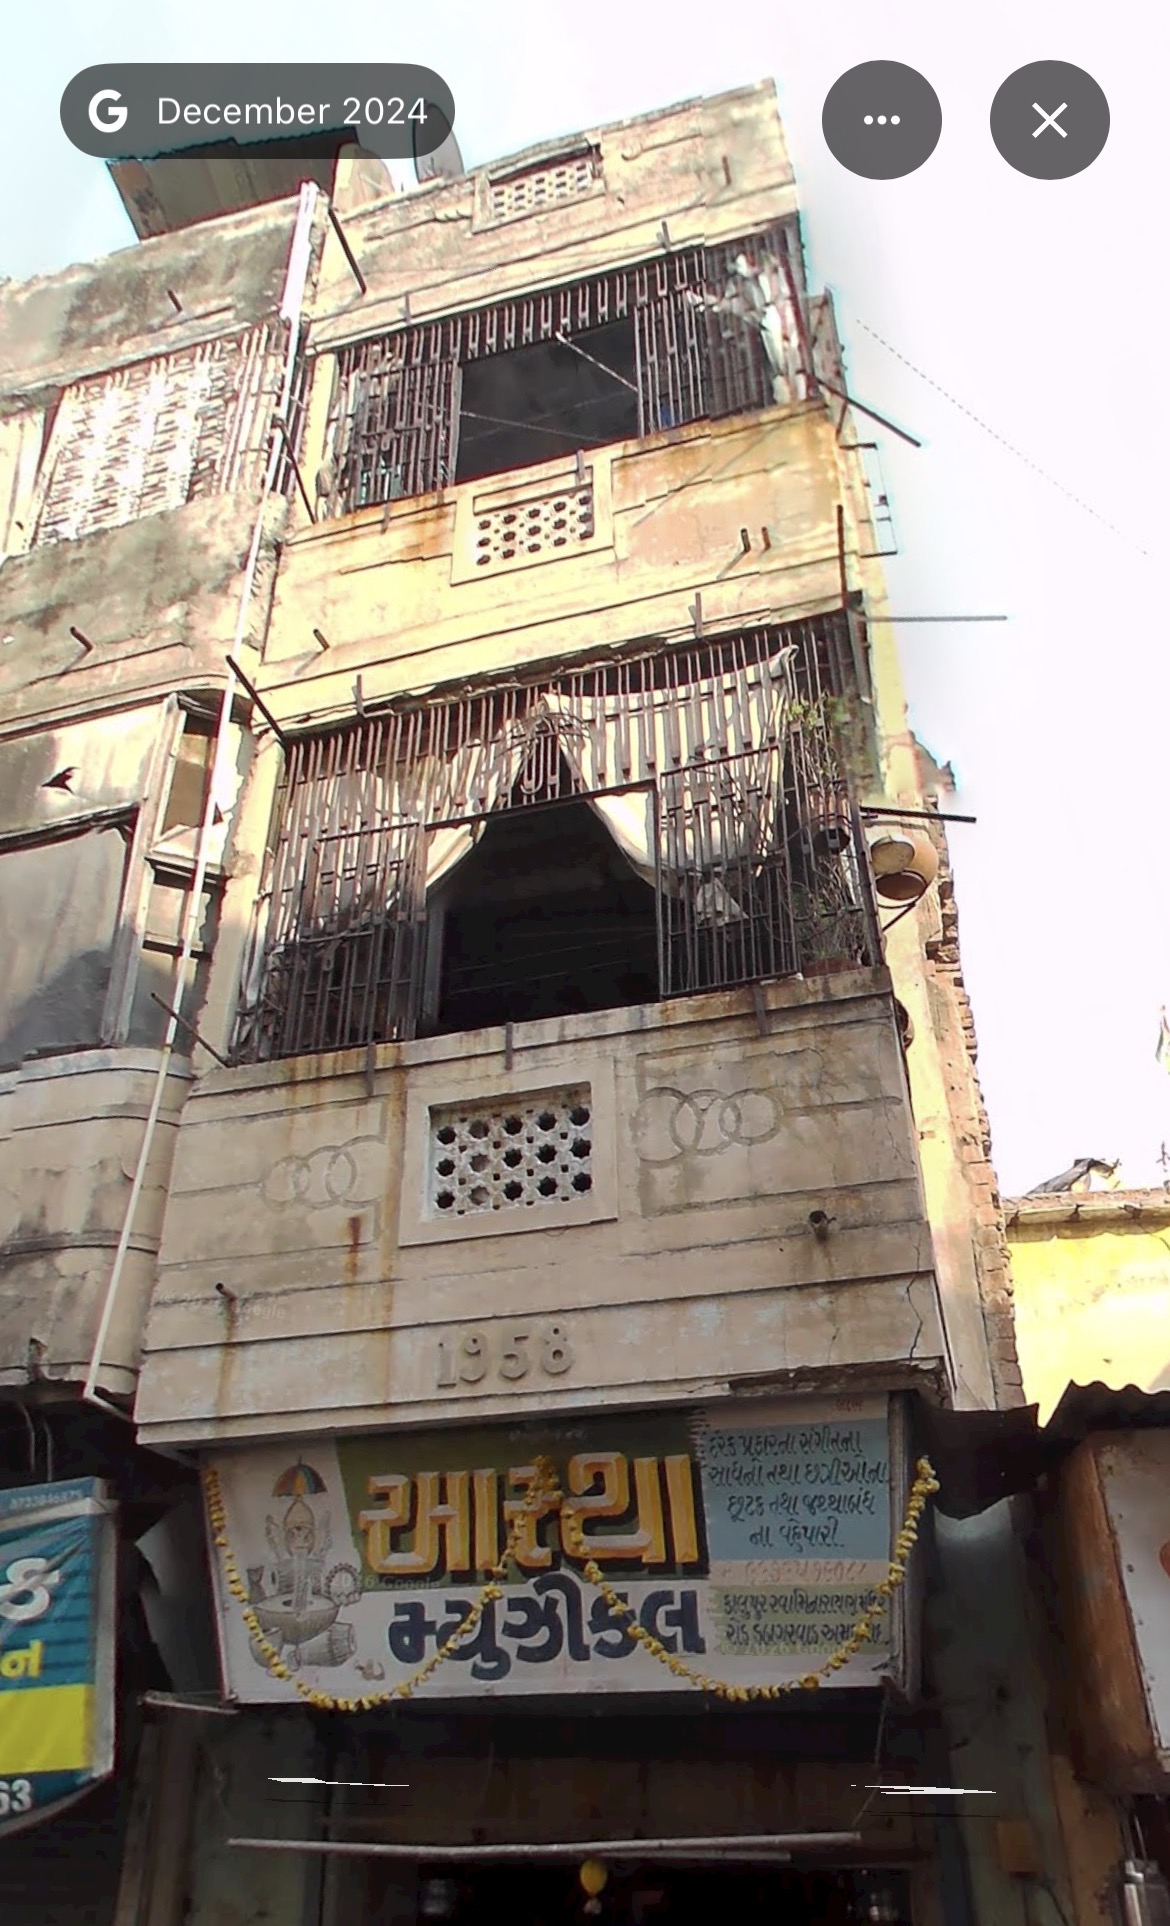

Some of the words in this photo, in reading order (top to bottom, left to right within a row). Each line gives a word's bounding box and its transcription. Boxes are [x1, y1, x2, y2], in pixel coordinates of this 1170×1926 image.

[435, 1321, 574, 1389] 1958
[766, 1462, 800, 1486] તથા
[358, 1450, 698, 1574] આસ્થા
[769, 1491, 800, 1516] તથા
[749, 1525, 773, 1547] ના
